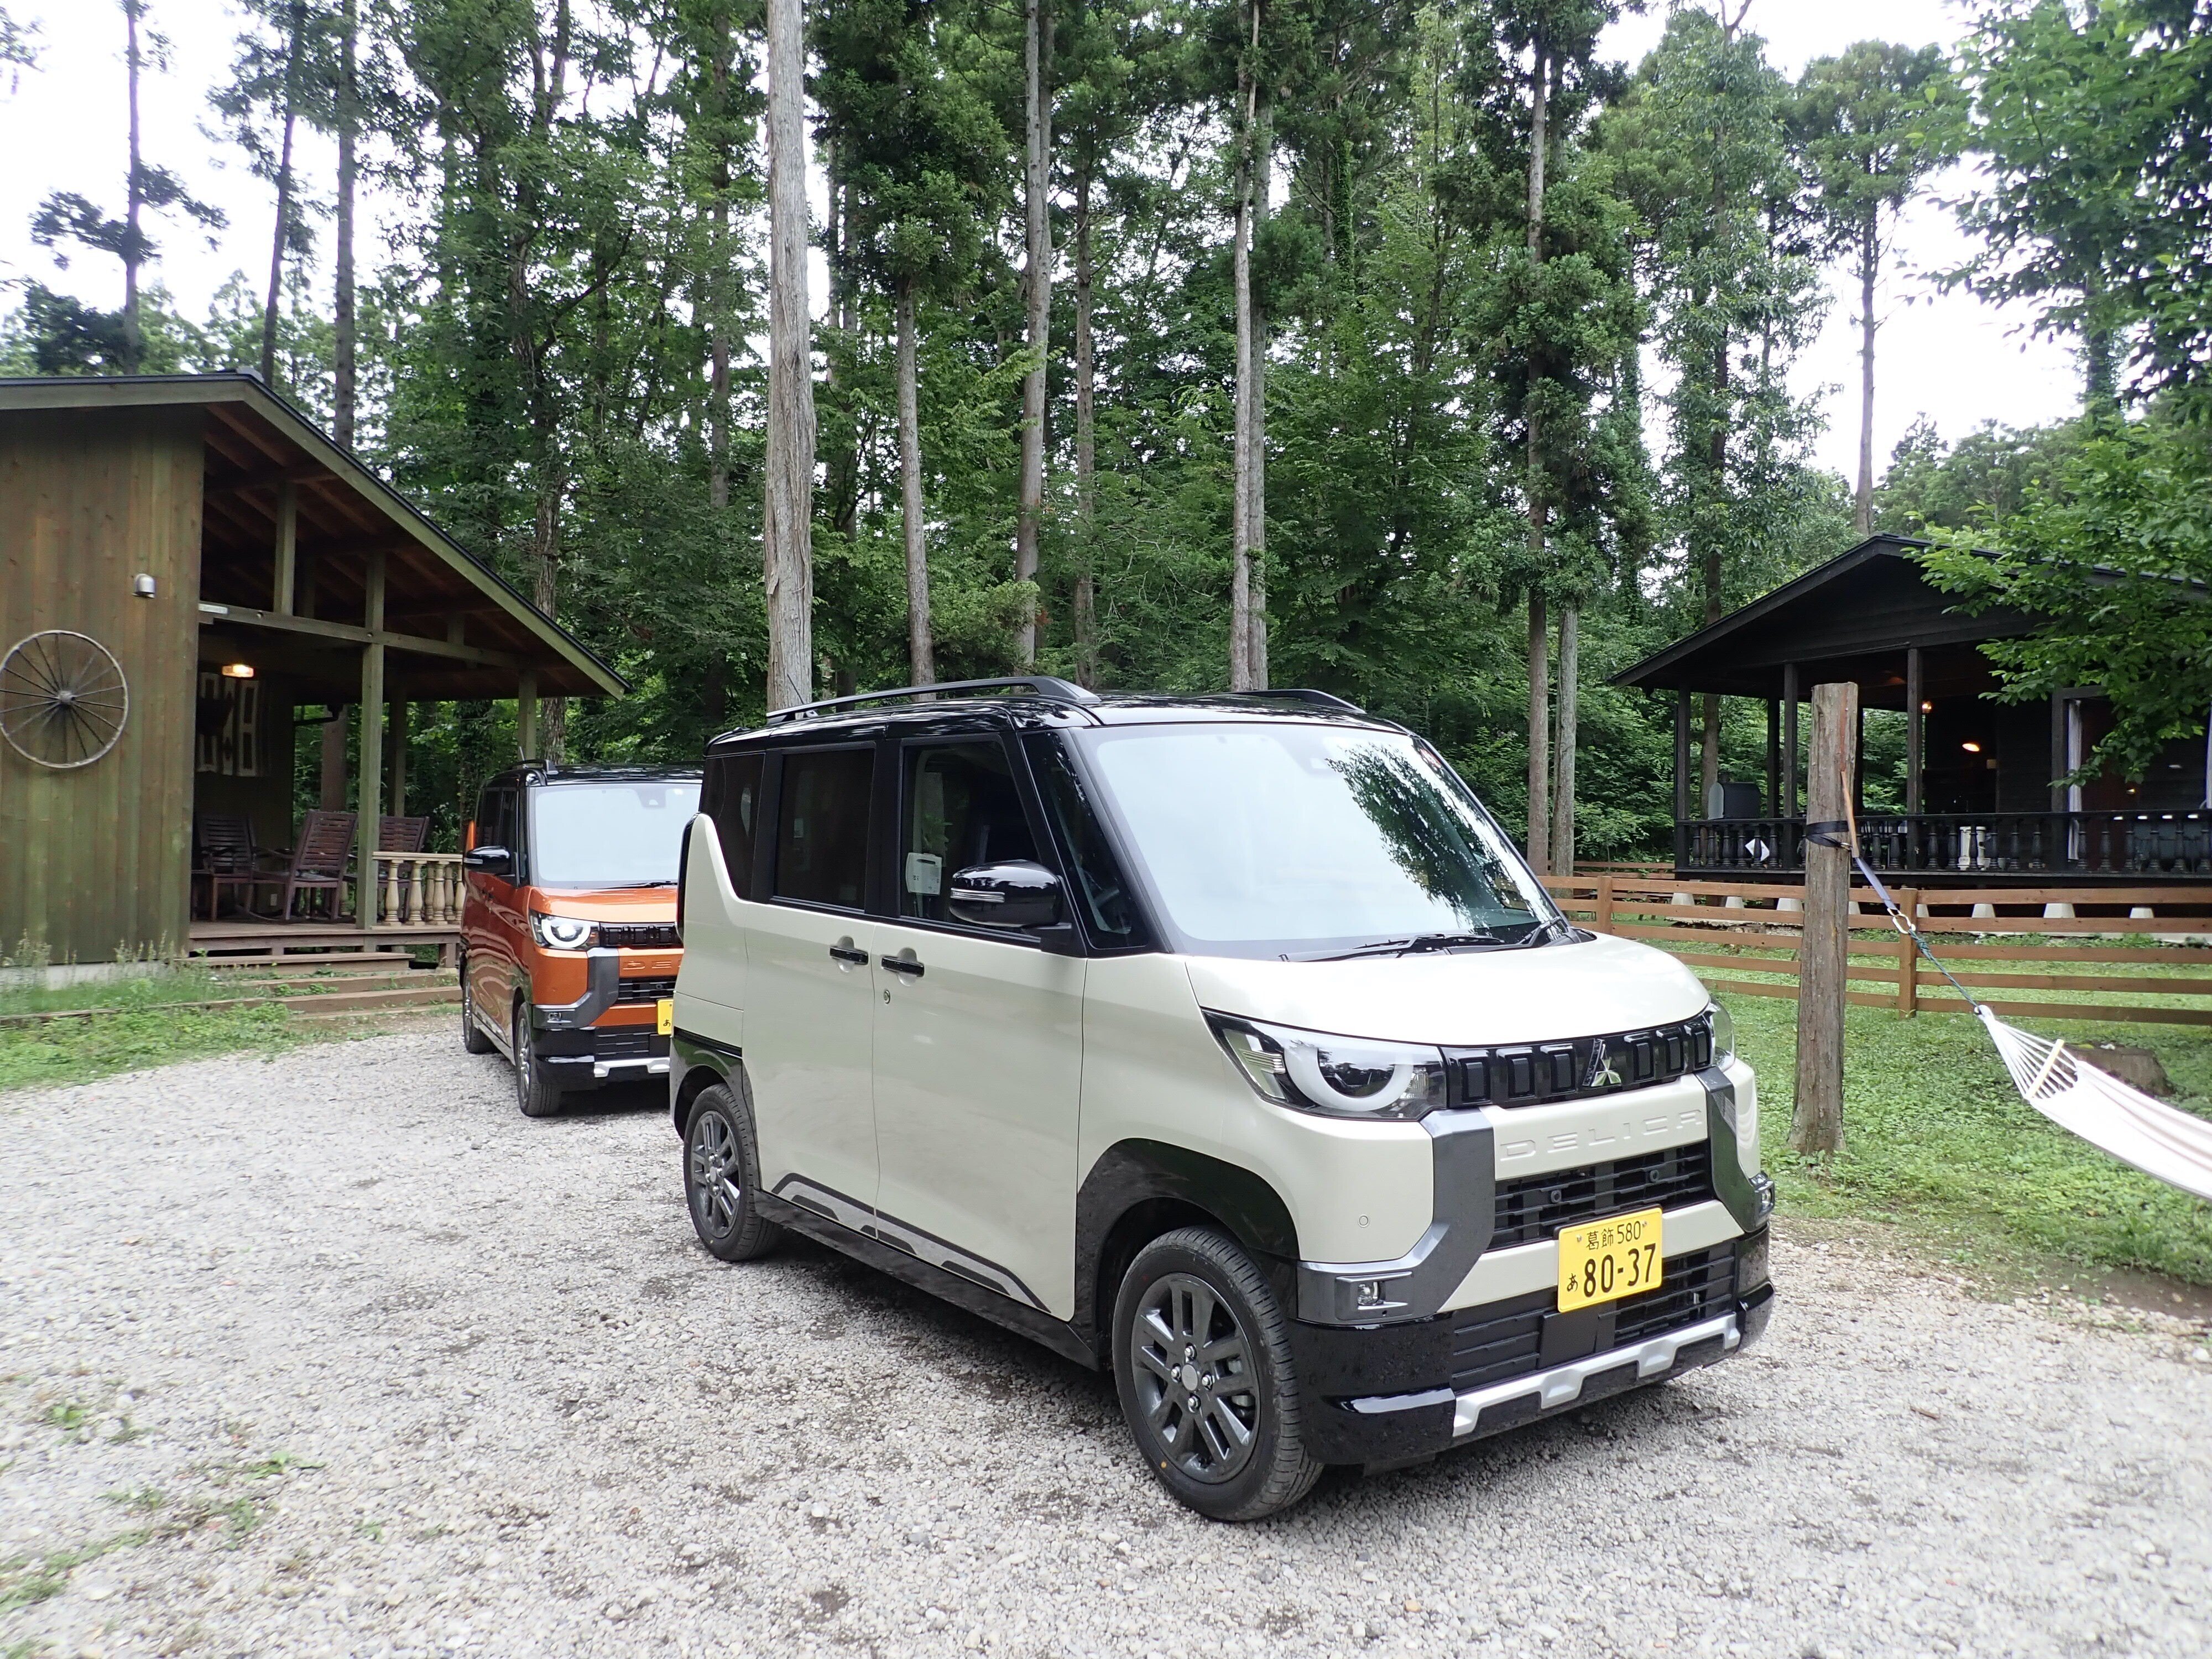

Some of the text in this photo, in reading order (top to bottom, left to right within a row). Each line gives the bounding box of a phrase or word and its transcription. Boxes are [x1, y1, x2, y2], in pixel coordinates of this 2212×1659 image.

[623, 960, 681, 970] DE
[663, 1019, 671, 1027] あ
[1499, 1109, 1703, 1161] DELICA
[1617, 1220, 1641, 1245] 580
[1566, 1243, 1656, 1298] あ 80-37
